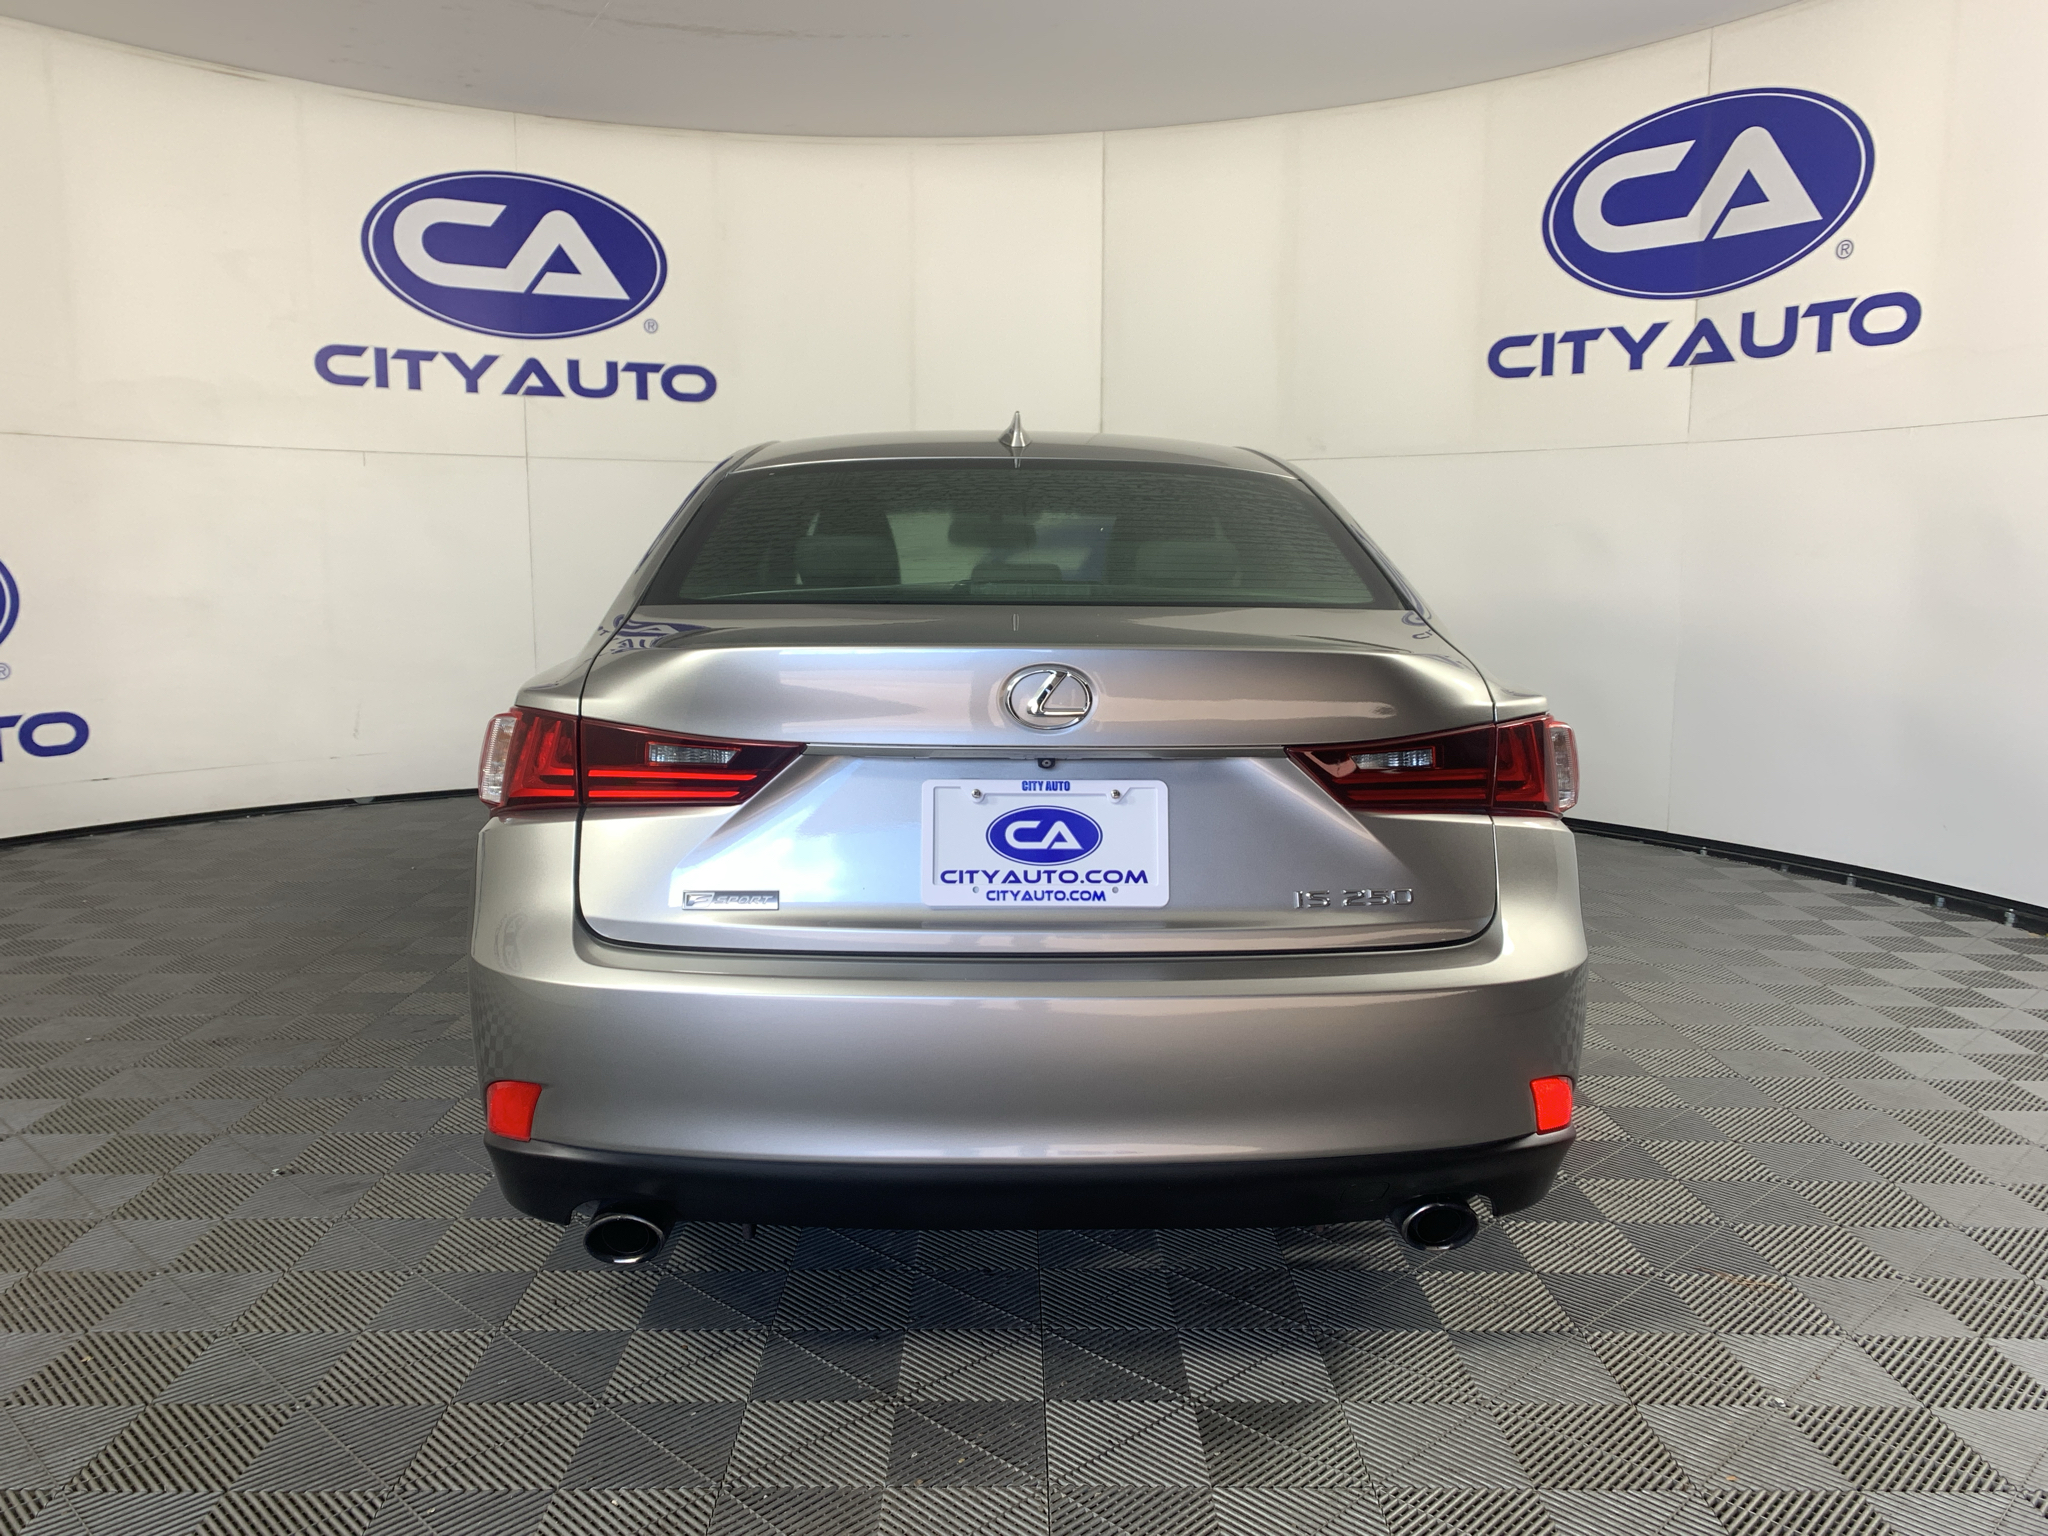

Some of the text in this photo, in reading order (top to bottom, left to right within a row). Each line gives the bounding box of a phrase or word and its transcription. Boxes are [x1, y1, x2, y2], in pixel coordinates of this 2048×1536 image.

[1573, 125, 1824, 253] CA
[393, 197, 631, 300] CA
[1487, 291, 1922, 379] CITY AUTO
[314, 344, 717, 402] CITY AUTO
[1021, 780, 1071, 791] CITY AUTO
[1005, 820, 1083, 850] CA
[940, 869, 1149, 885] CITYAUTO.COM
[714, 895, 773, 905] SPORT
[986, 890, 1107, 902] CITYAUTO.COM
[1293, 889, 1414, 909] IS 250
